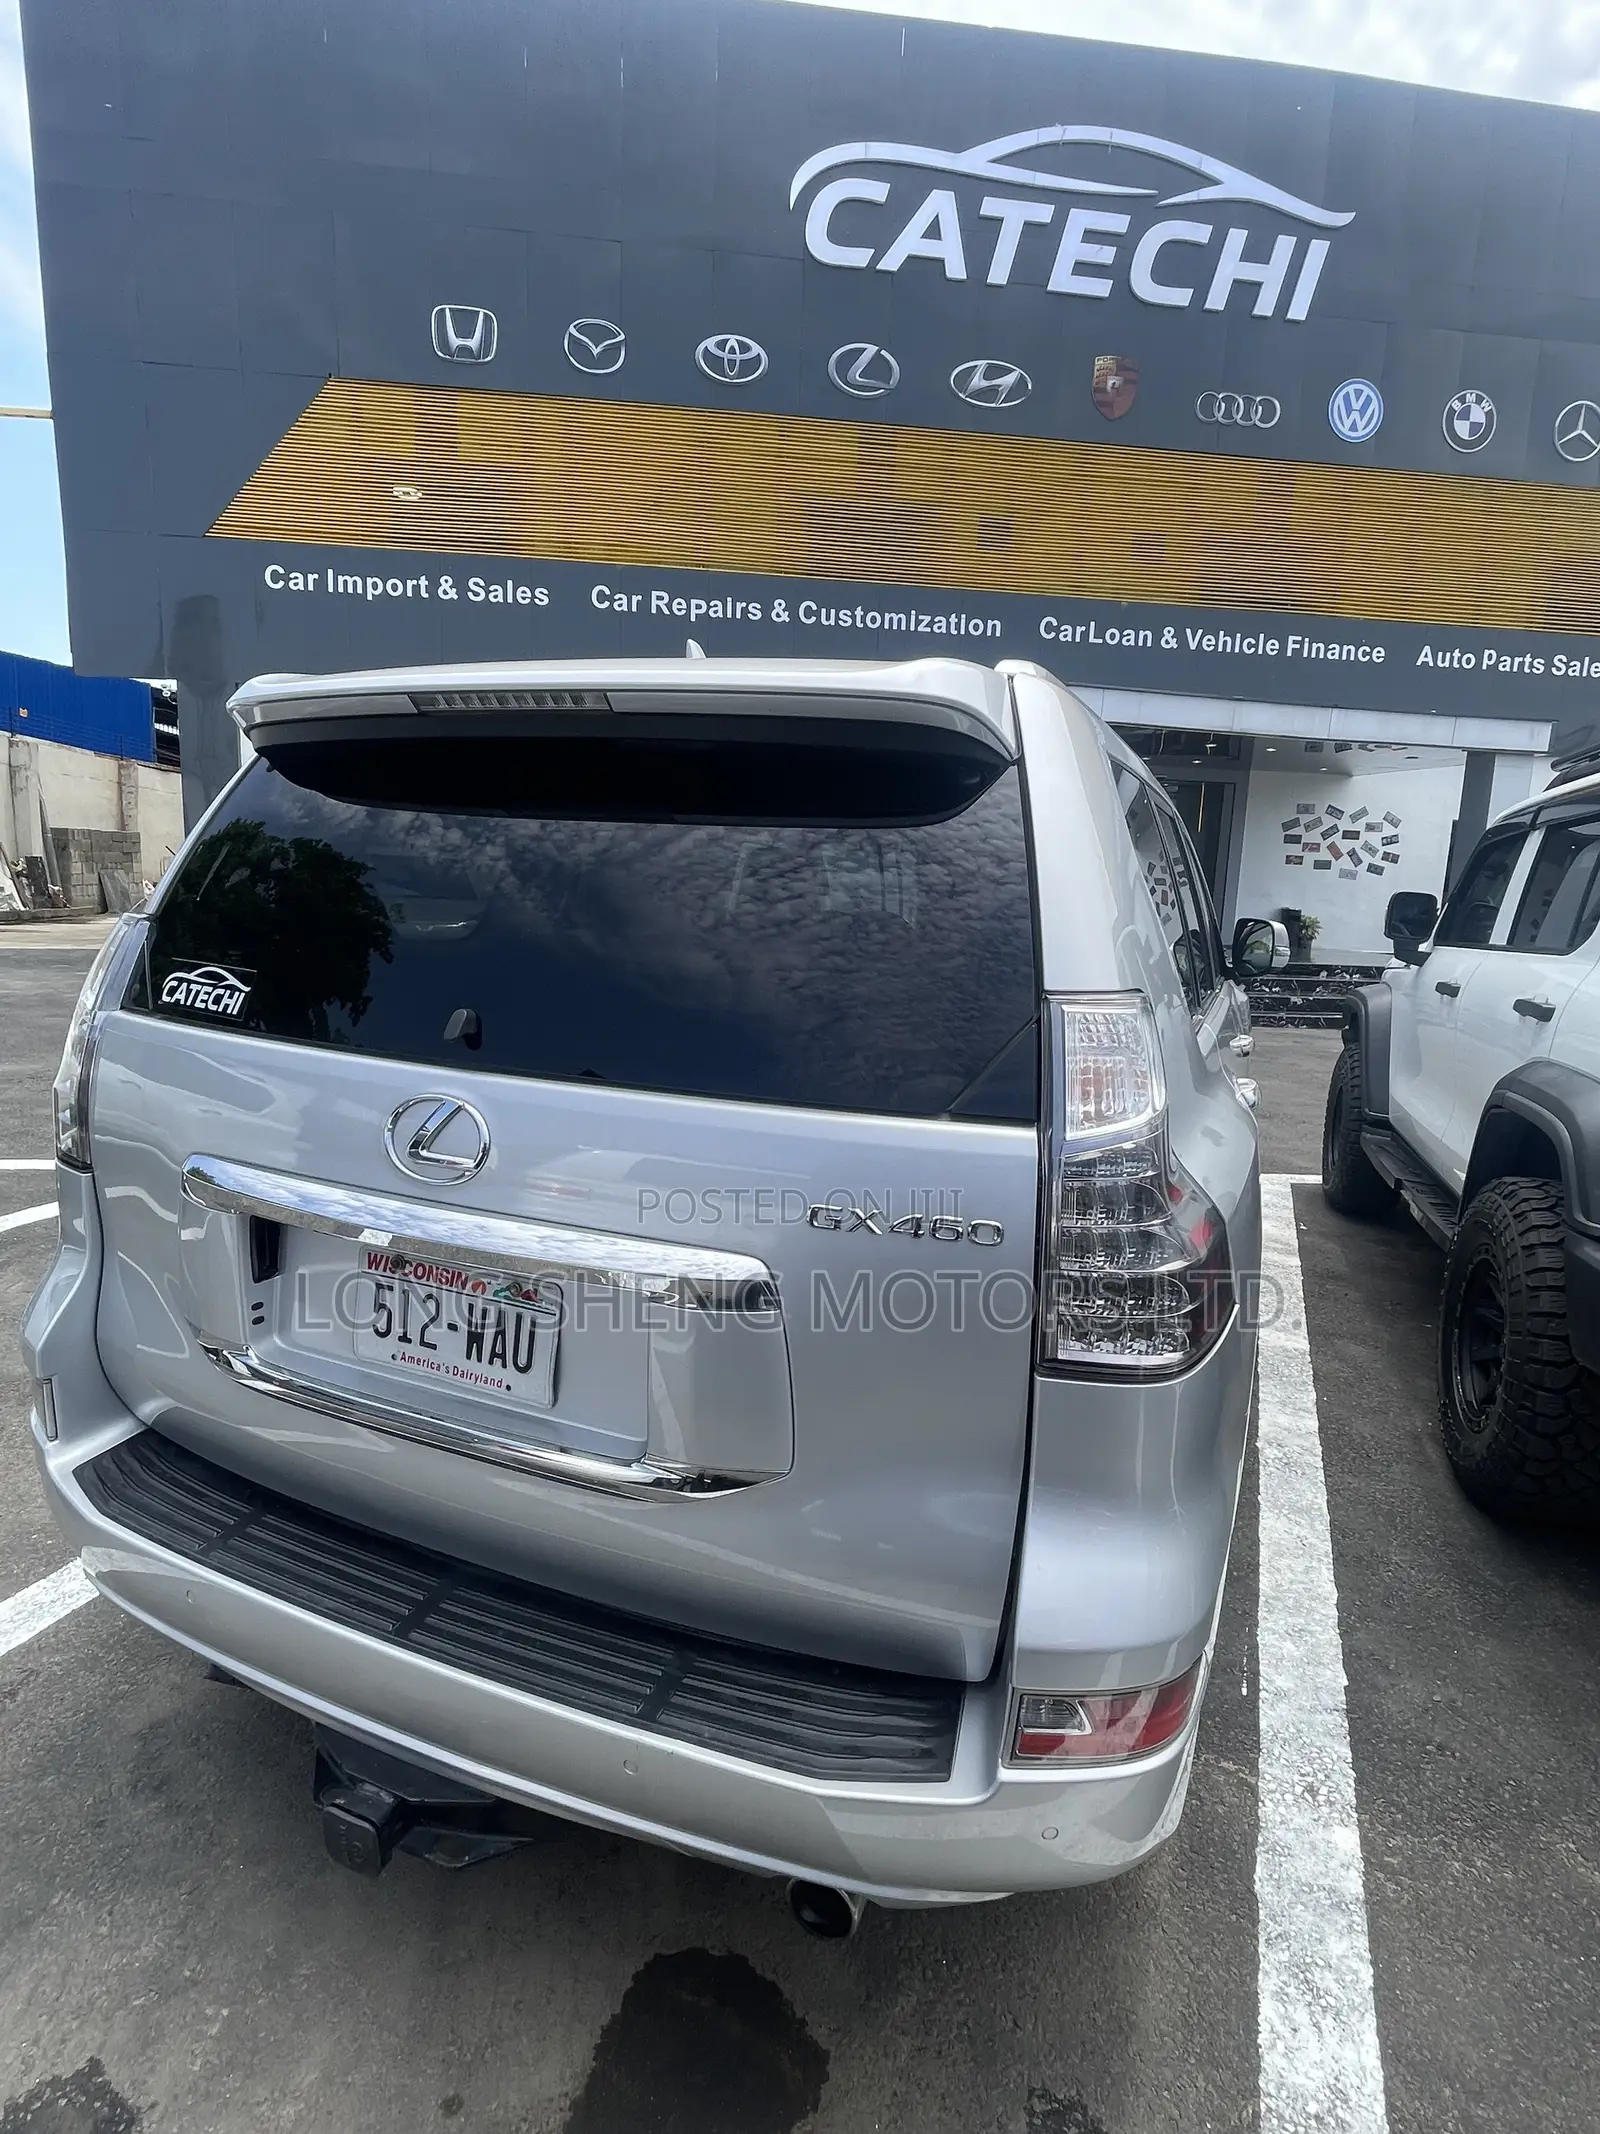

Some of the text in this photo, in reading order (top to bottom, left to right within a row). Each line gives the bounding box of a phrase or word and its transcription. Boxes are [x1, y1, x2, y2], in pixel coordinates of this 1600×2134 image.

[804, 177, 1331, 321] CATECHI
[1451, 392, 1493, 412] BMW
[264, 564, 550, 606] Car Import & Sales
[591, 585, 1002, 637] Car Repairs & Customization
[1160, 626, 1178, 649] &
[1185, 628, 1280, 656] Vehicle
[1286, 635, 1386, 663] Finance
[1416, 645, 1600, 678] Auto Parts Sale
[162, 980, 245, 1014] CATECHI
[372, 1281, 537, 1375] 512-WAU
[400, 1351, 503, 1388] America's Dairyland
